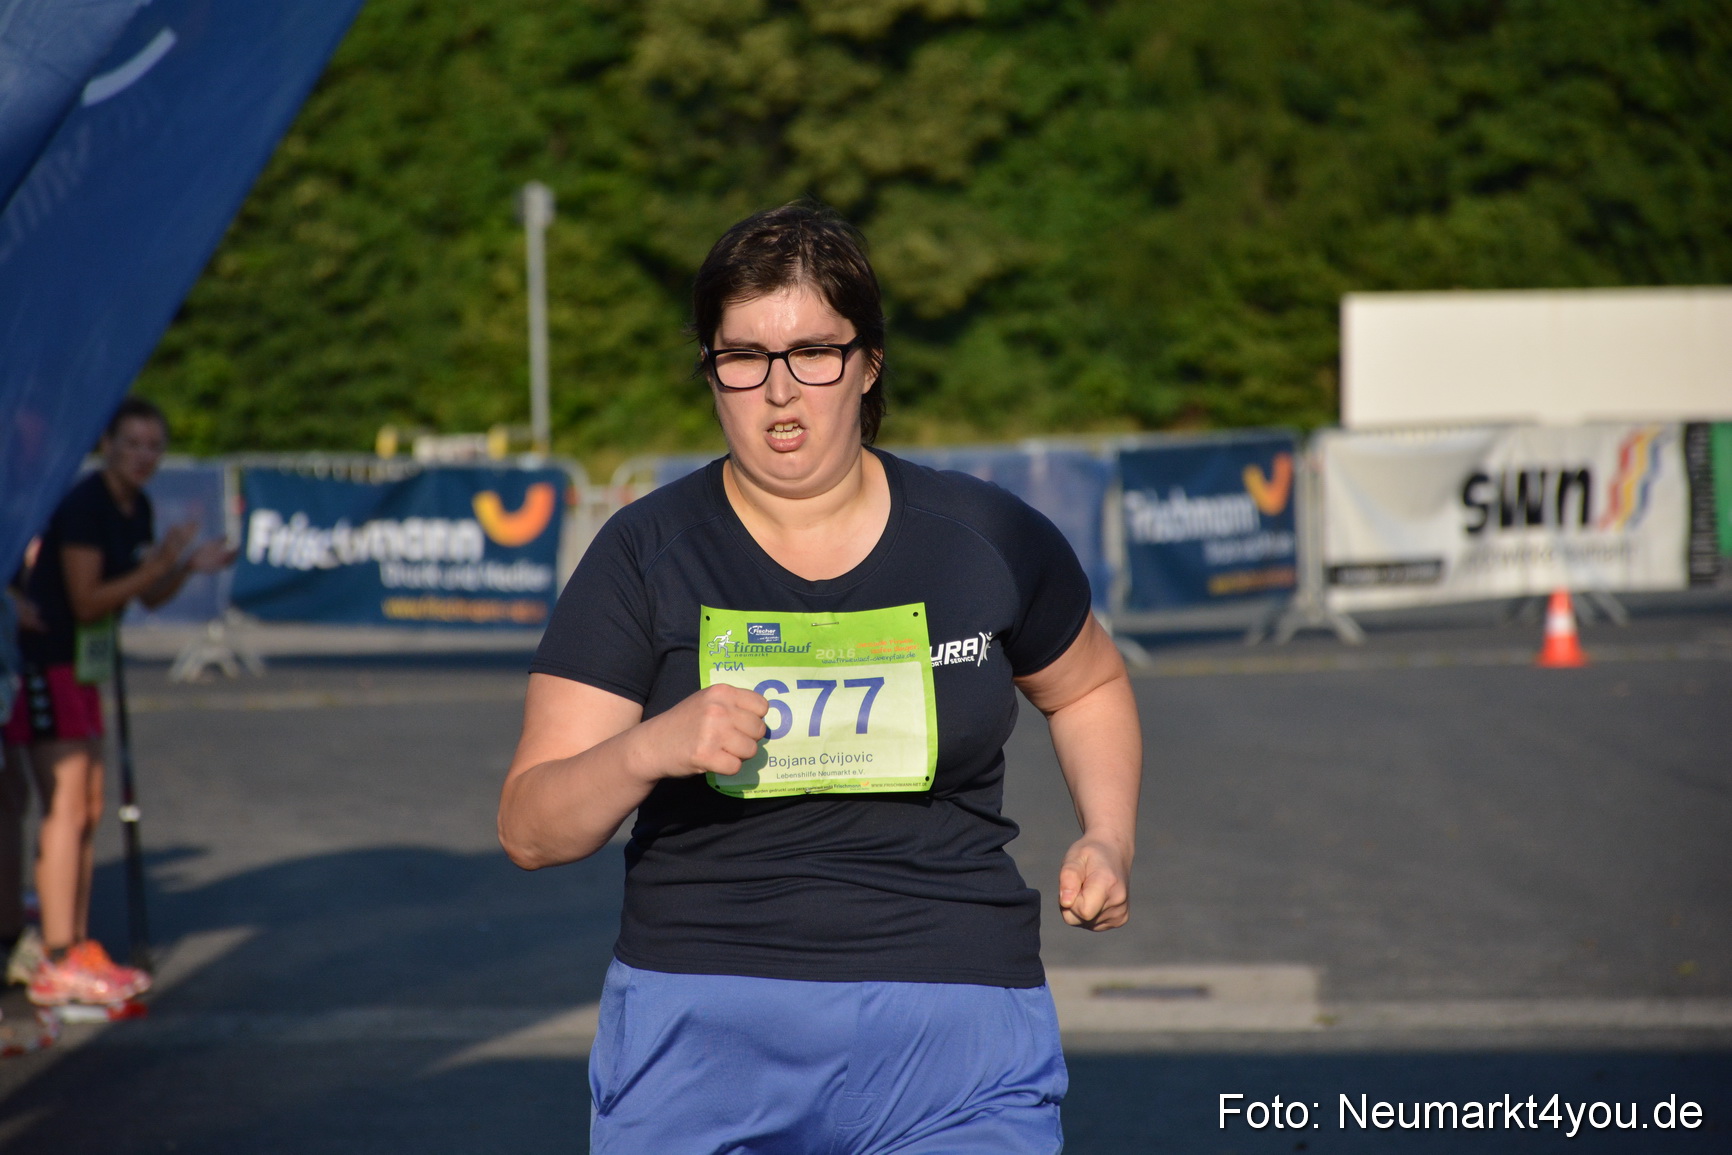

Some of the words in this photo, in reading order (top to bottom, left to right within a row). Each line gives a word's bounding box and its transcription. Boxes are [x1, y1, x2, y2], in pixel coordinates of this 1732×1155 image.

[734, 641, 812, 654] firmenlauf
[815, 648, 856, 660] 2016
[949, 655, 975, 664] SERVICE
[753, 676, 885, 740] 677
[768, 755, 816, 769] Bojana
[819, 751, 874, 766] Cvijovic
[776, 771, 817, 779] Lebenshilfe
[818, 769, 851, 777] Neumarkt
